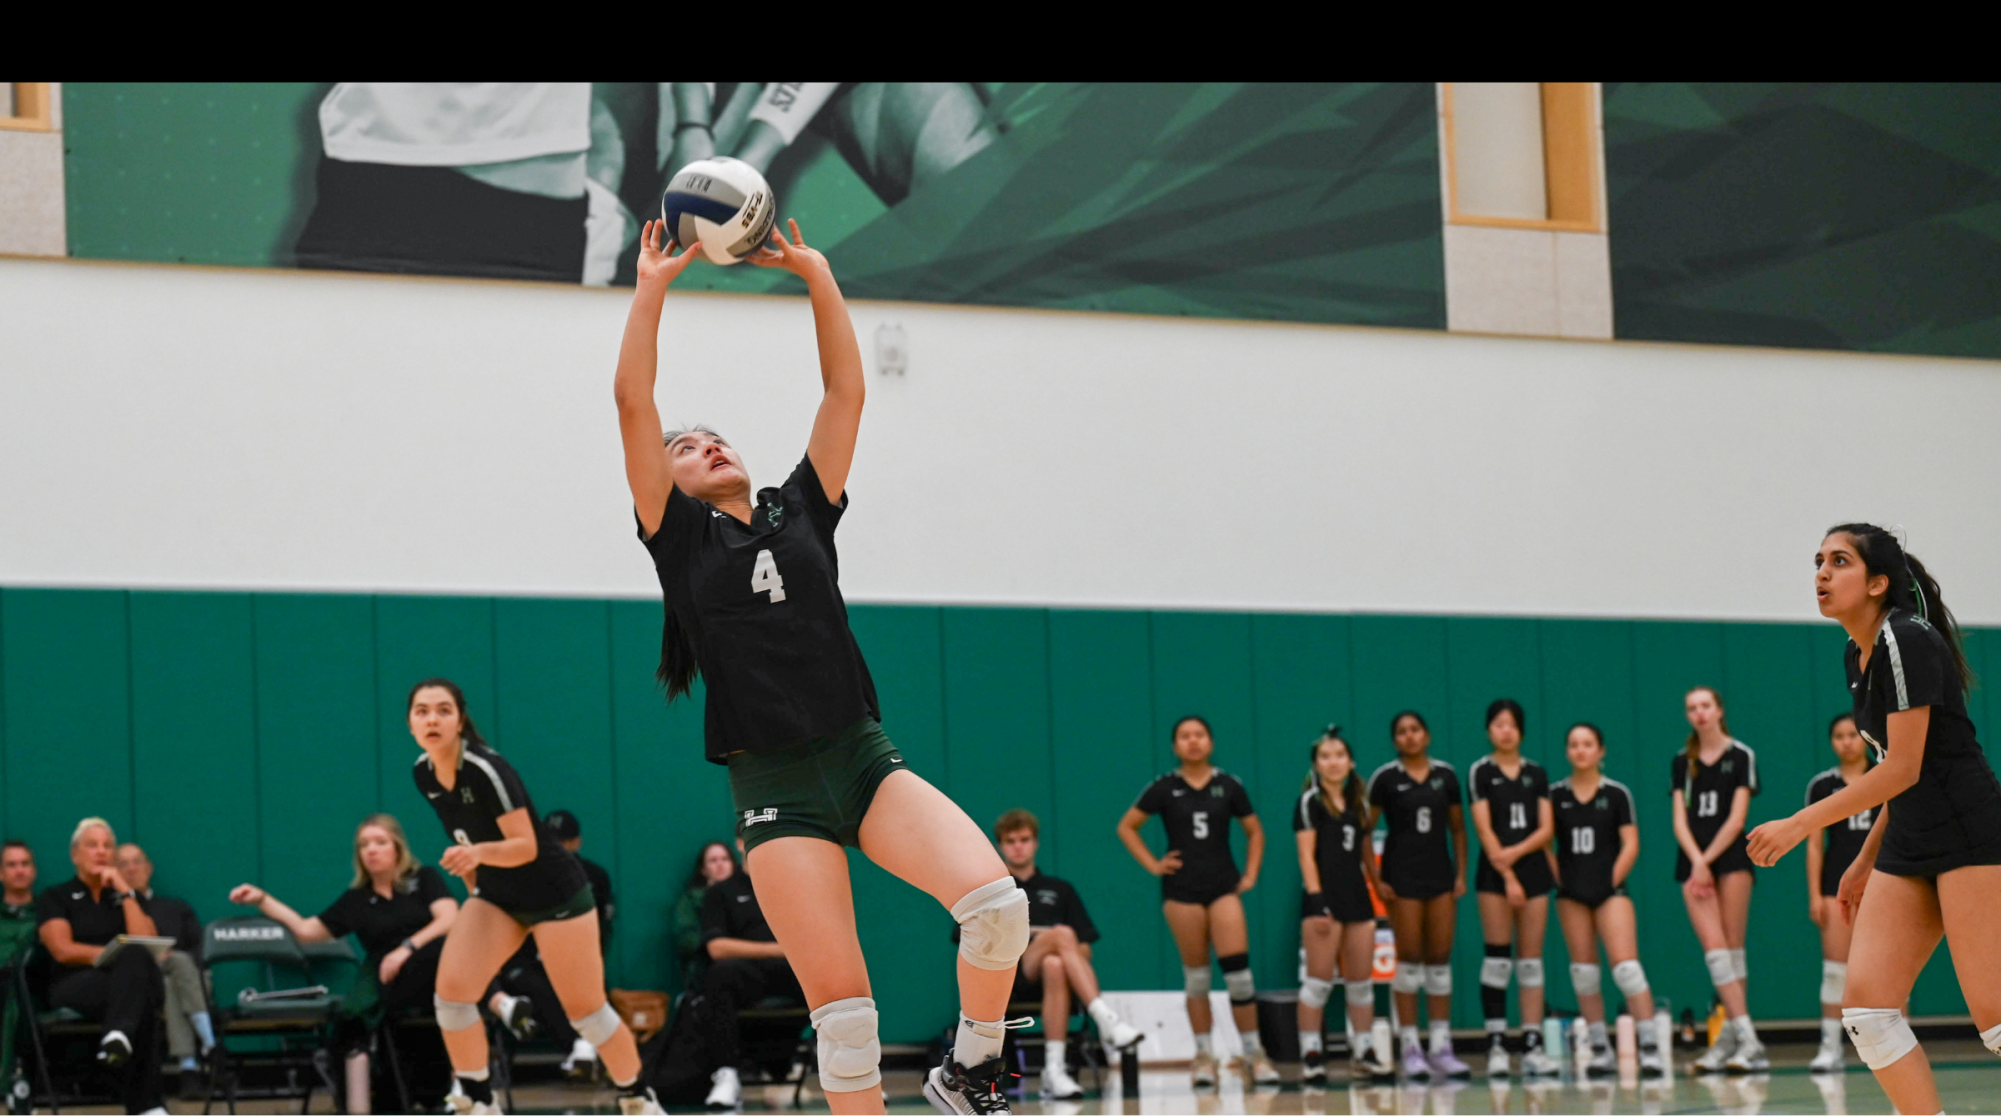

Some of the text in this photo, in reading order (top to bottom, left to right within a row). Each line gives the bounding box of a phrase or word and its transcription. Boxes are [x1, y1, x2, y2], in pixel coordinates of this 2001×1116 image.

[751, 549, 786, 604] 4
[1697, 789, 1718, 818] 13
[1192, 811, 1209, 840] 5
[1416, 806, 1432, 834] 6
[1848, 809, 1872, 830] 12
[1342, 824, 1356, 851] 3
[1571, 826, 1595, 854] 10
[213, 926, 285, 941] HARKER
